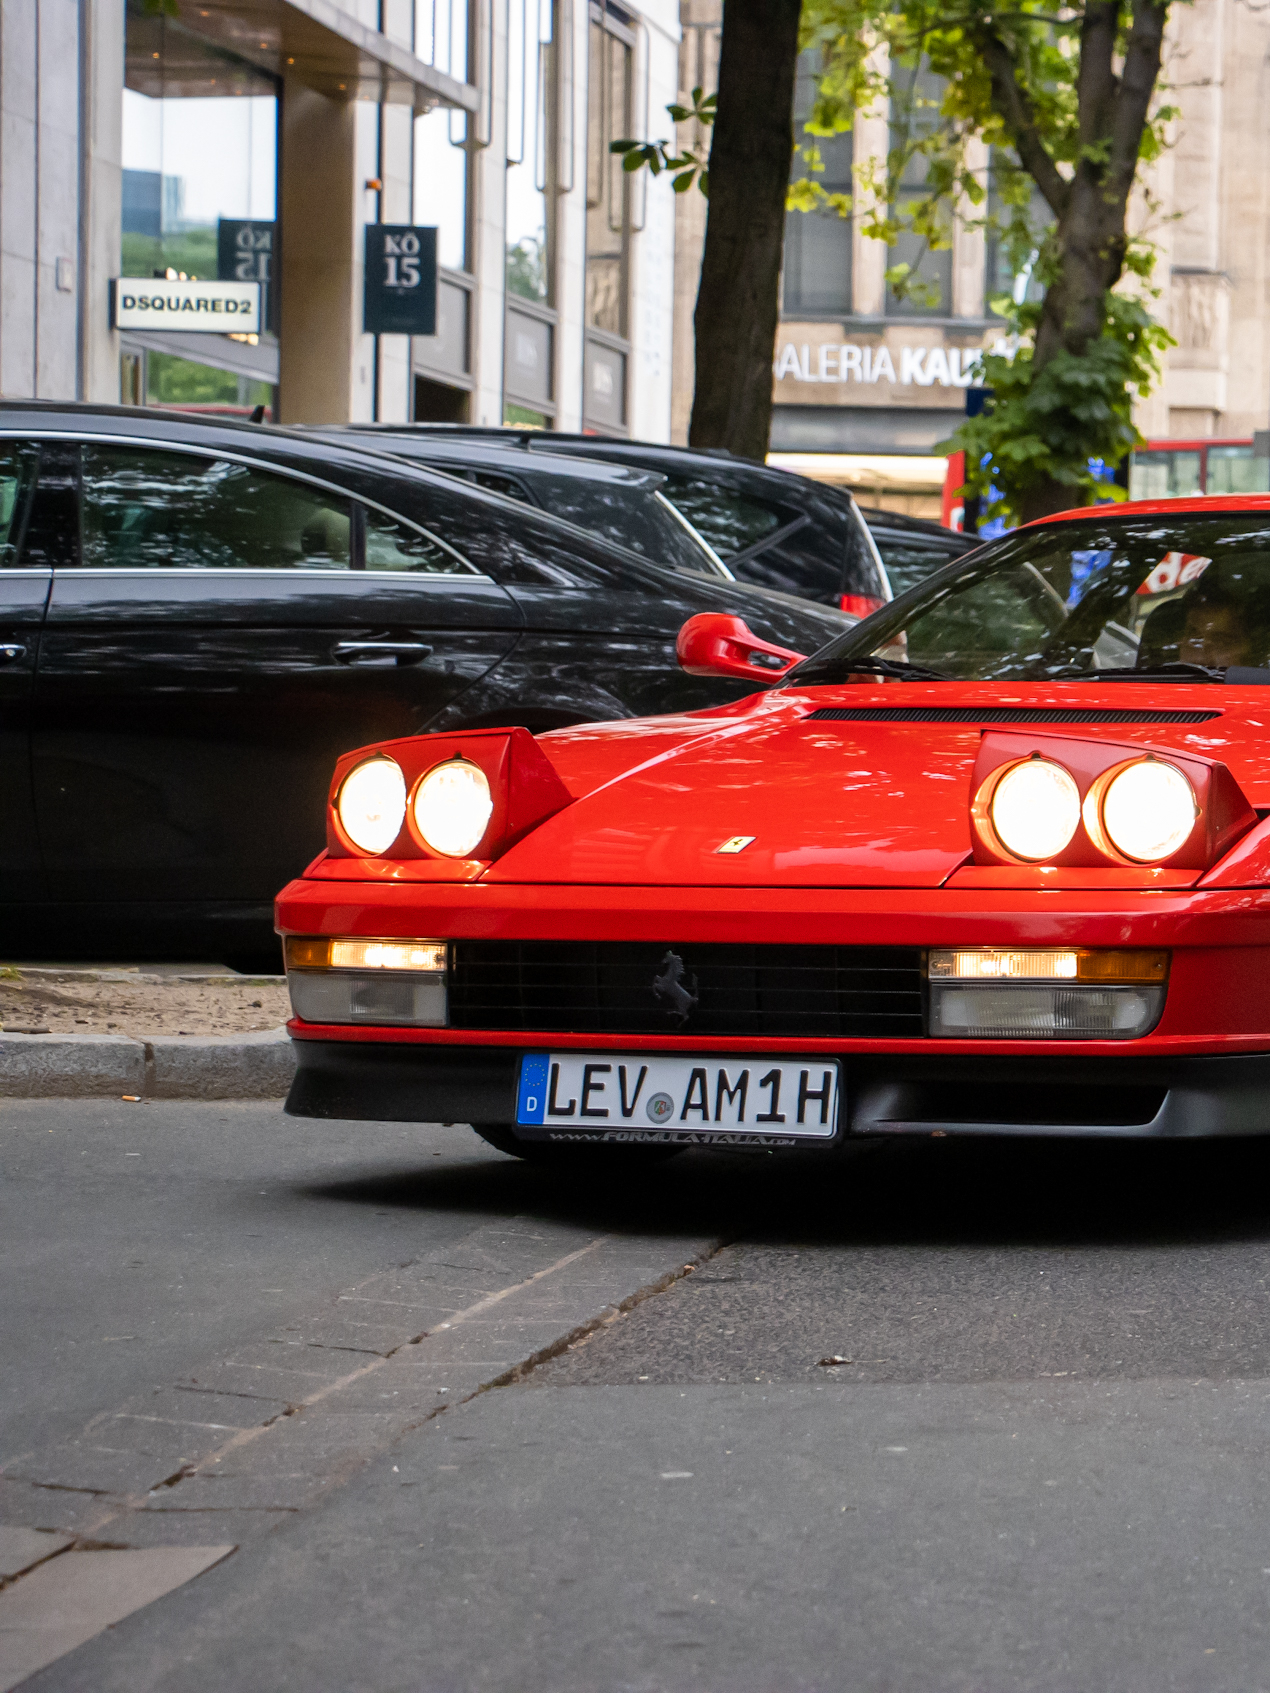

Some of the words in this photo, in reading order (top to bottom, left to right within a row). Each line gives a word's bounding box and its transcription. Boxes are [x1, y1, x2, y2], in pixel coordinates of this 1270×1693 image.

[384, 257, 421, 287] 15
[122, 295, 252, 315] DSQUARED2
[774, 342, 896, 384] ALERIA
[526, 1096, 537, 1112] D
[547, 1062, 649, 1118] LEV
